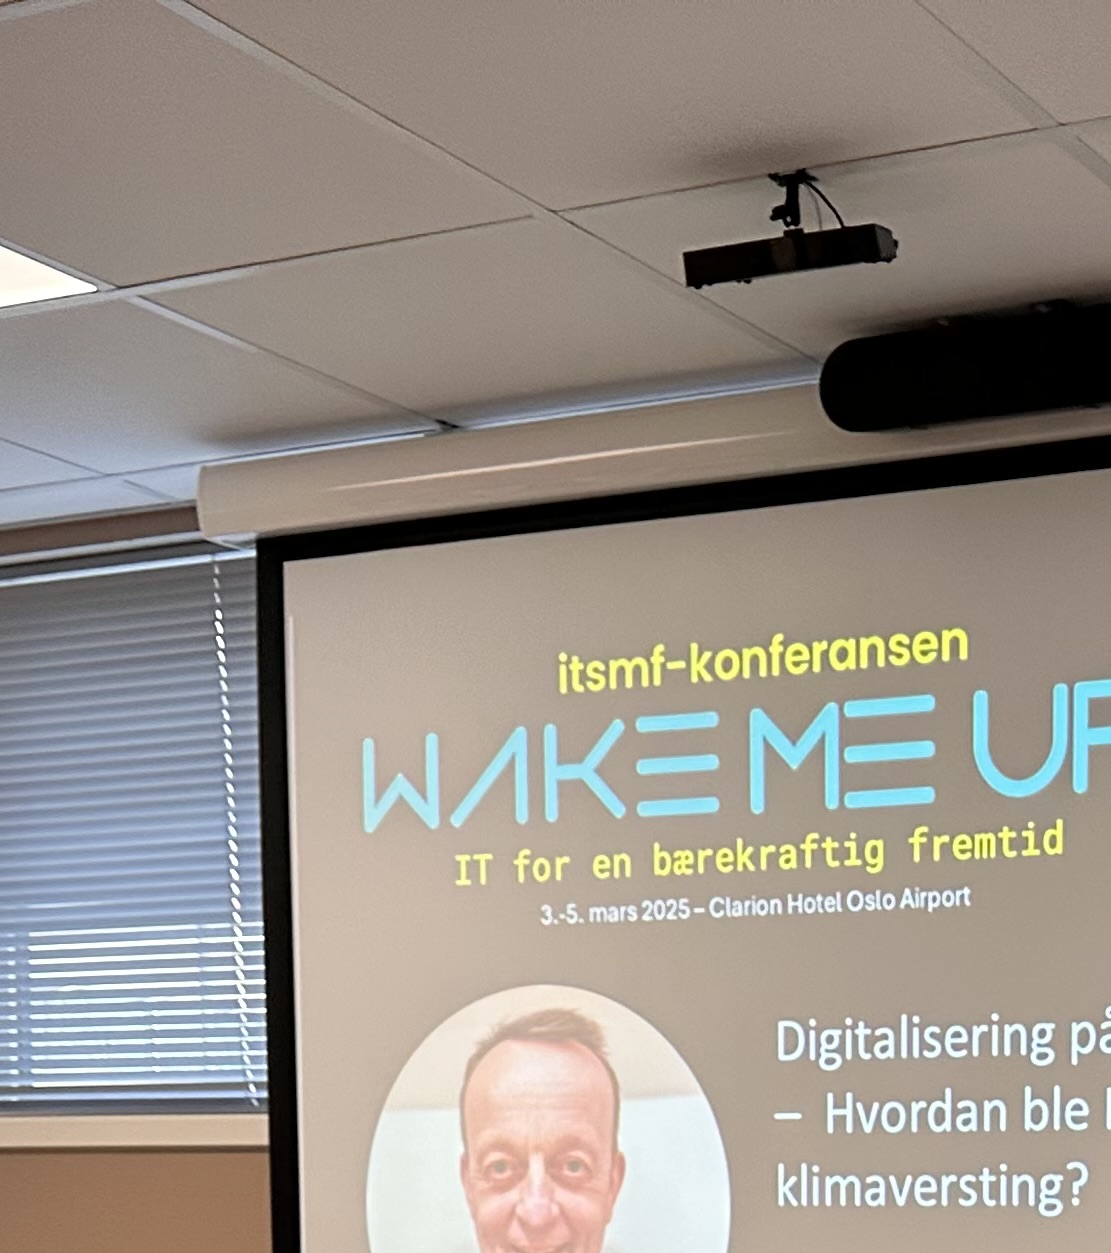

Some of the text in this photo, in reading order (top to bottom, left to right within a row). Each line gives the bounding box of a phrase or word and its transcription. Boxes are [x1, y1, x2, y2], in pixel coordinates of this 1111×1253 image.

[558, 627, 969, 695] itsmf-konferansen
[362, 711, 720, 834] WAKE
[749, 694, 937, 815] ME
[454, 819, 1064, 886] IT for en bærekraftig fremtid
[540, 903, 585, 926] 3.-5.
[588, 904, 639, 923] mars
[641, 897, 691, 922] 2025
[708, 895, 783, 919] Clarion
[787, 891, 843, 915] Hotel
[846, 889, 897, 912] Oslo
[899, 886, 971, 913] Airport
[777, 1012, 1056, 1072] Digitalisering
[826, 1087, 1007, 1134] Hvordan
[1024, 1084, 1090, 1132] ble
[777, 1161, 1089, 1218] klimaversting?
